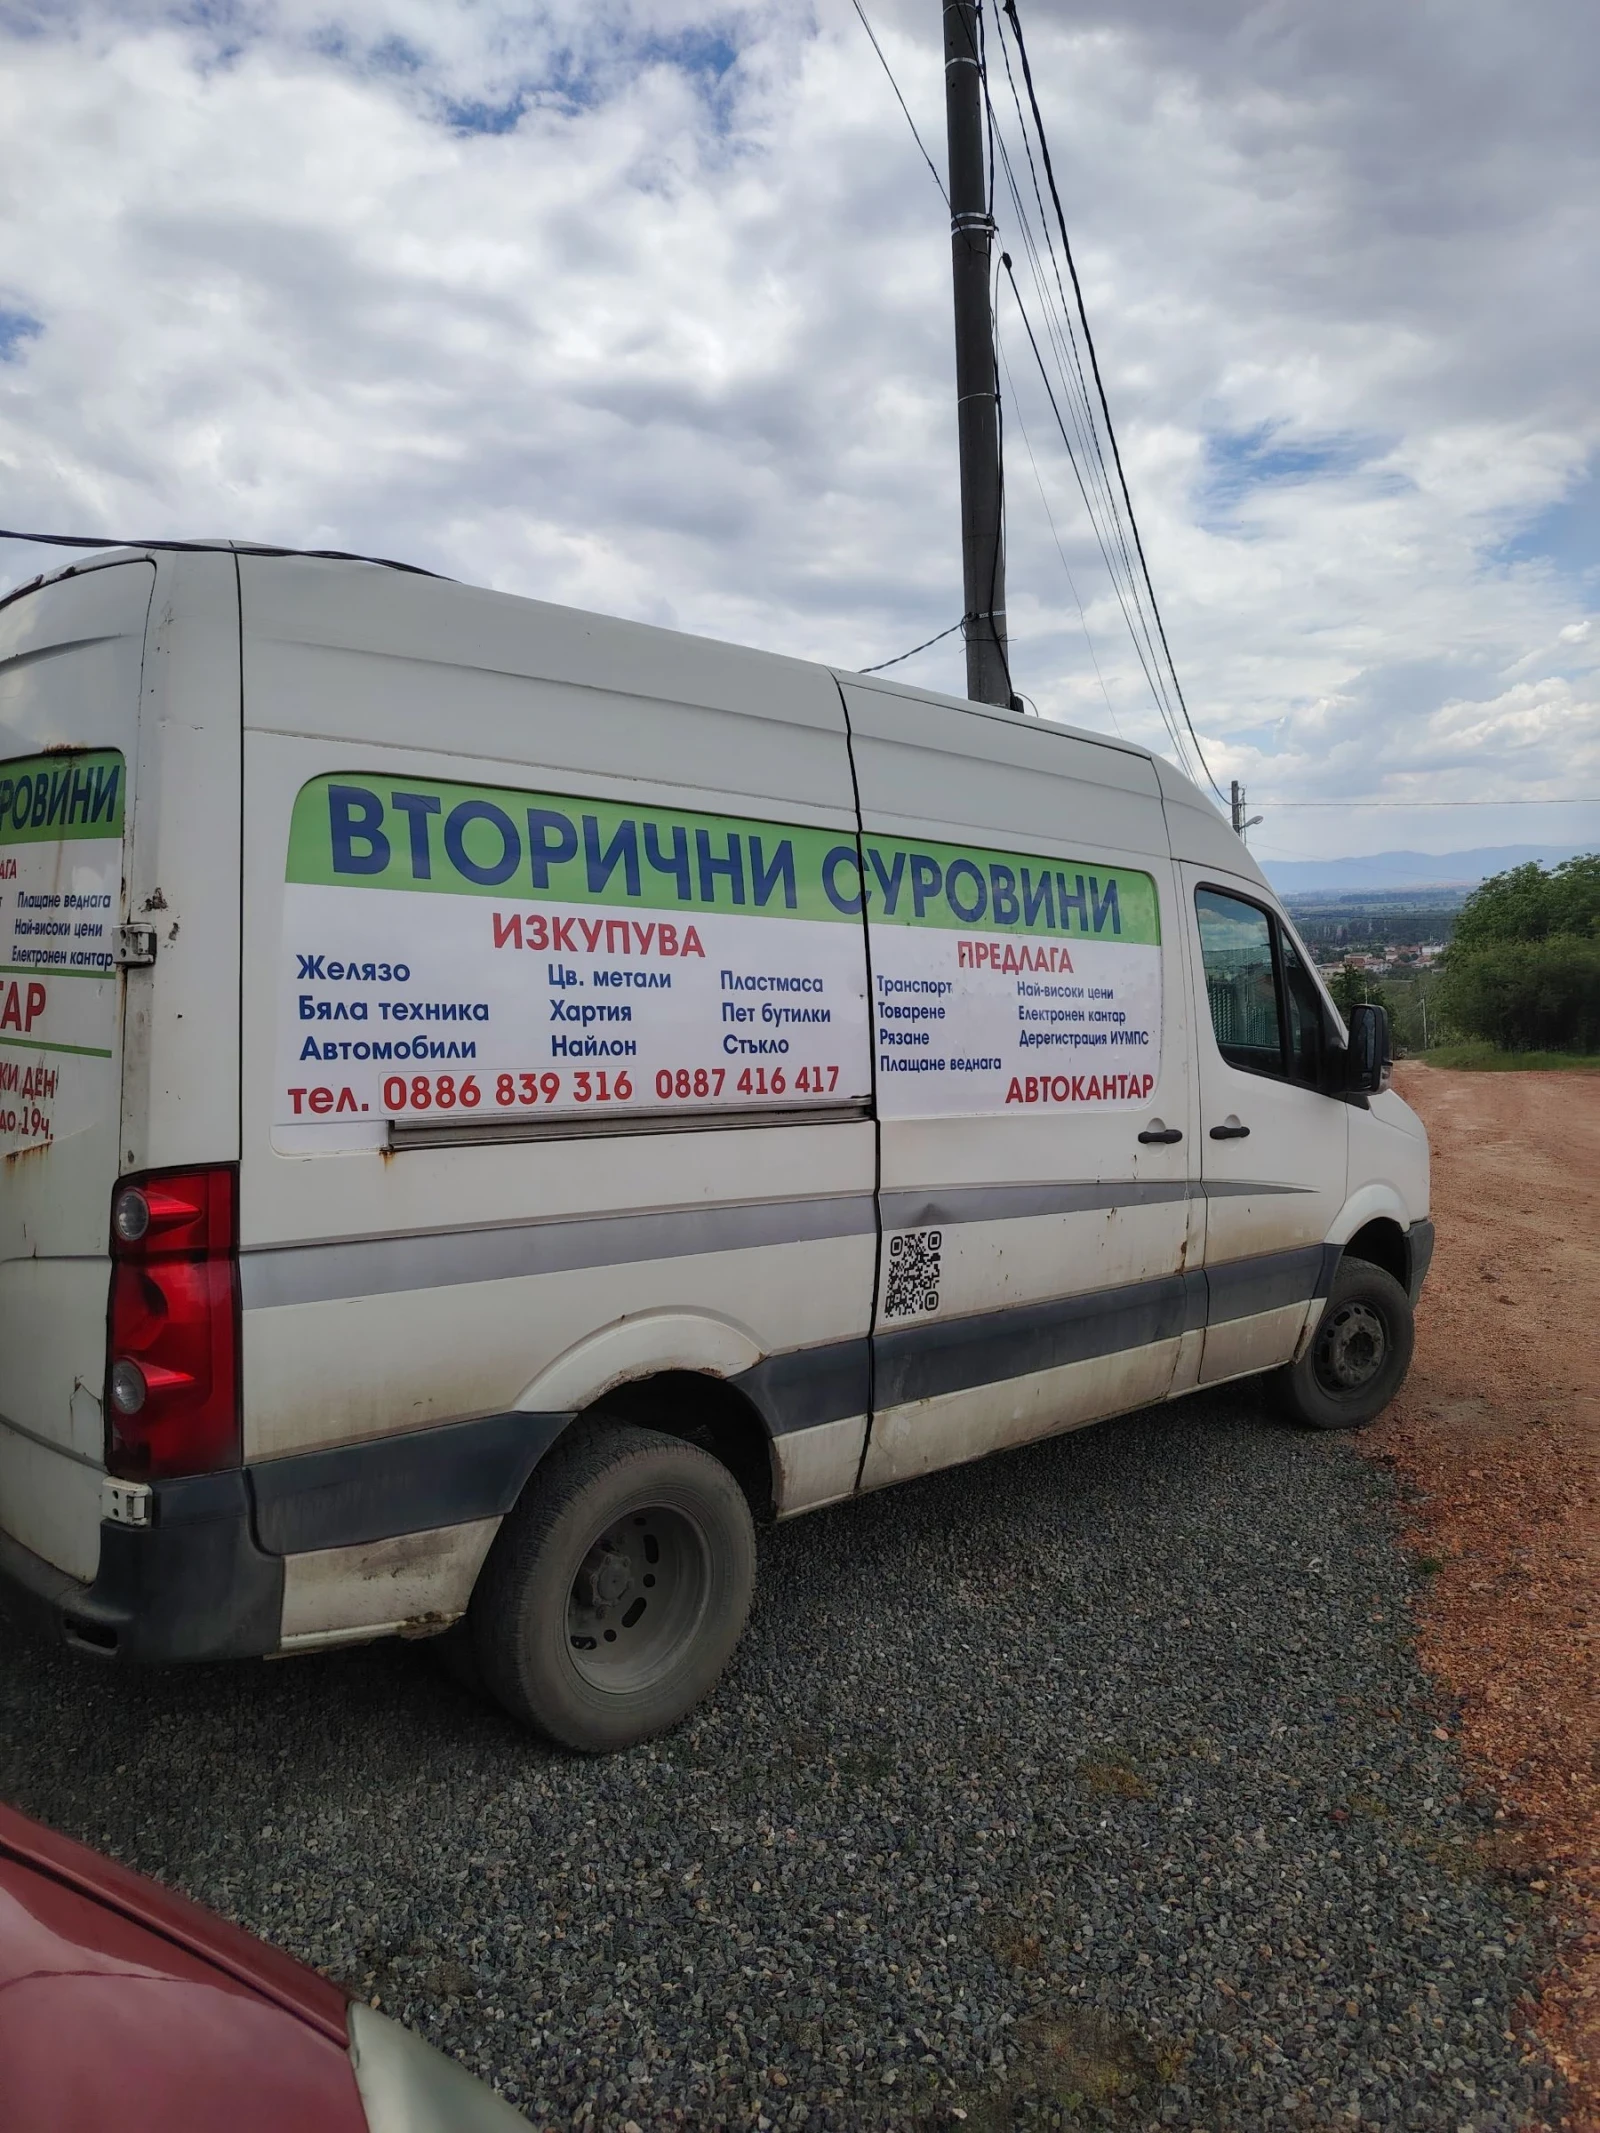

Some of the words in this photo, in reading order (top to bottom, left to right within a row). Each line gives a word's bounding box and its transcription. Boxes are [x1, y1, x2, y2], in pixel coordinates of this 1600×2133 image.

[327, 784, 797, 909] ВТОРИЧНИ
[821, 845, 1121, 935] СУРОВИНИ
[17, 891, 61, 909] Плащане
[63, 893, 111, 910] веднага
[14, 918, 71, 936] Най-високи
[74, 923, 103, 938] цени
[492, 912, 706, 958] ИЗКУПУВА
[11, 945, 67, 967] Електронен
[69, 951, 114, 972] кантар
[296, 954, 411, 982] Желязо
[957, 940, 1075, 975] ПРЕДЛАГА
[547, 963, 584, 989] Цв.
[593, 970, 672, 988] метали
[720, 969, 824, 993] Пластмаса
[876, 974, 953, 998] Транспорт
[1017, 980, 1085, 999] Най-високи
[1087, 987, 1114, 1000] цени
[299, 995, 368, 1021] Бяла
[378, 1002, 489, 1021] техника
[549, 999, 632, 1027] Хартия
[722, 1002, 756, 1022] Пет
[761, 1003, 831, 1028] бутилки
[878, 1001, 946, 1023] Товарене
[1018, 1005, 1085, 1025] Електронен
[1088, 1010, 1126, 1026] кантар
[299, 1035, 477, 1061] Автомобили
[551, 1035, 637, 1057] Найлон
[723, 1034, 789, 1054] Стъкло
[879, 1028, 930, 1045] Рязане
[1019, 1029, 1107, 1049] Дерегистрация
[1110, 1030, 1149, 1045] ИУМПС
[880, 1055, 946, 1073] Плащане
[950, 1057, 1002, 1072] веднага
[22, 1066, 55, 1101] ДЕН
[287, 1086, 369, 1115] тел.
[383, 1075, 481, 1111] 0886
[495, 1072, 560, 1106] 839
[573, 1070, 633, 1102] 316
[655, 1068, 726, 1099] 0887
[736, 1066, 786, 1096] 416
[795, 1065, 840, 1093] 417
[1005, 1073, 1154, 1104] АВТОКАНТАР
